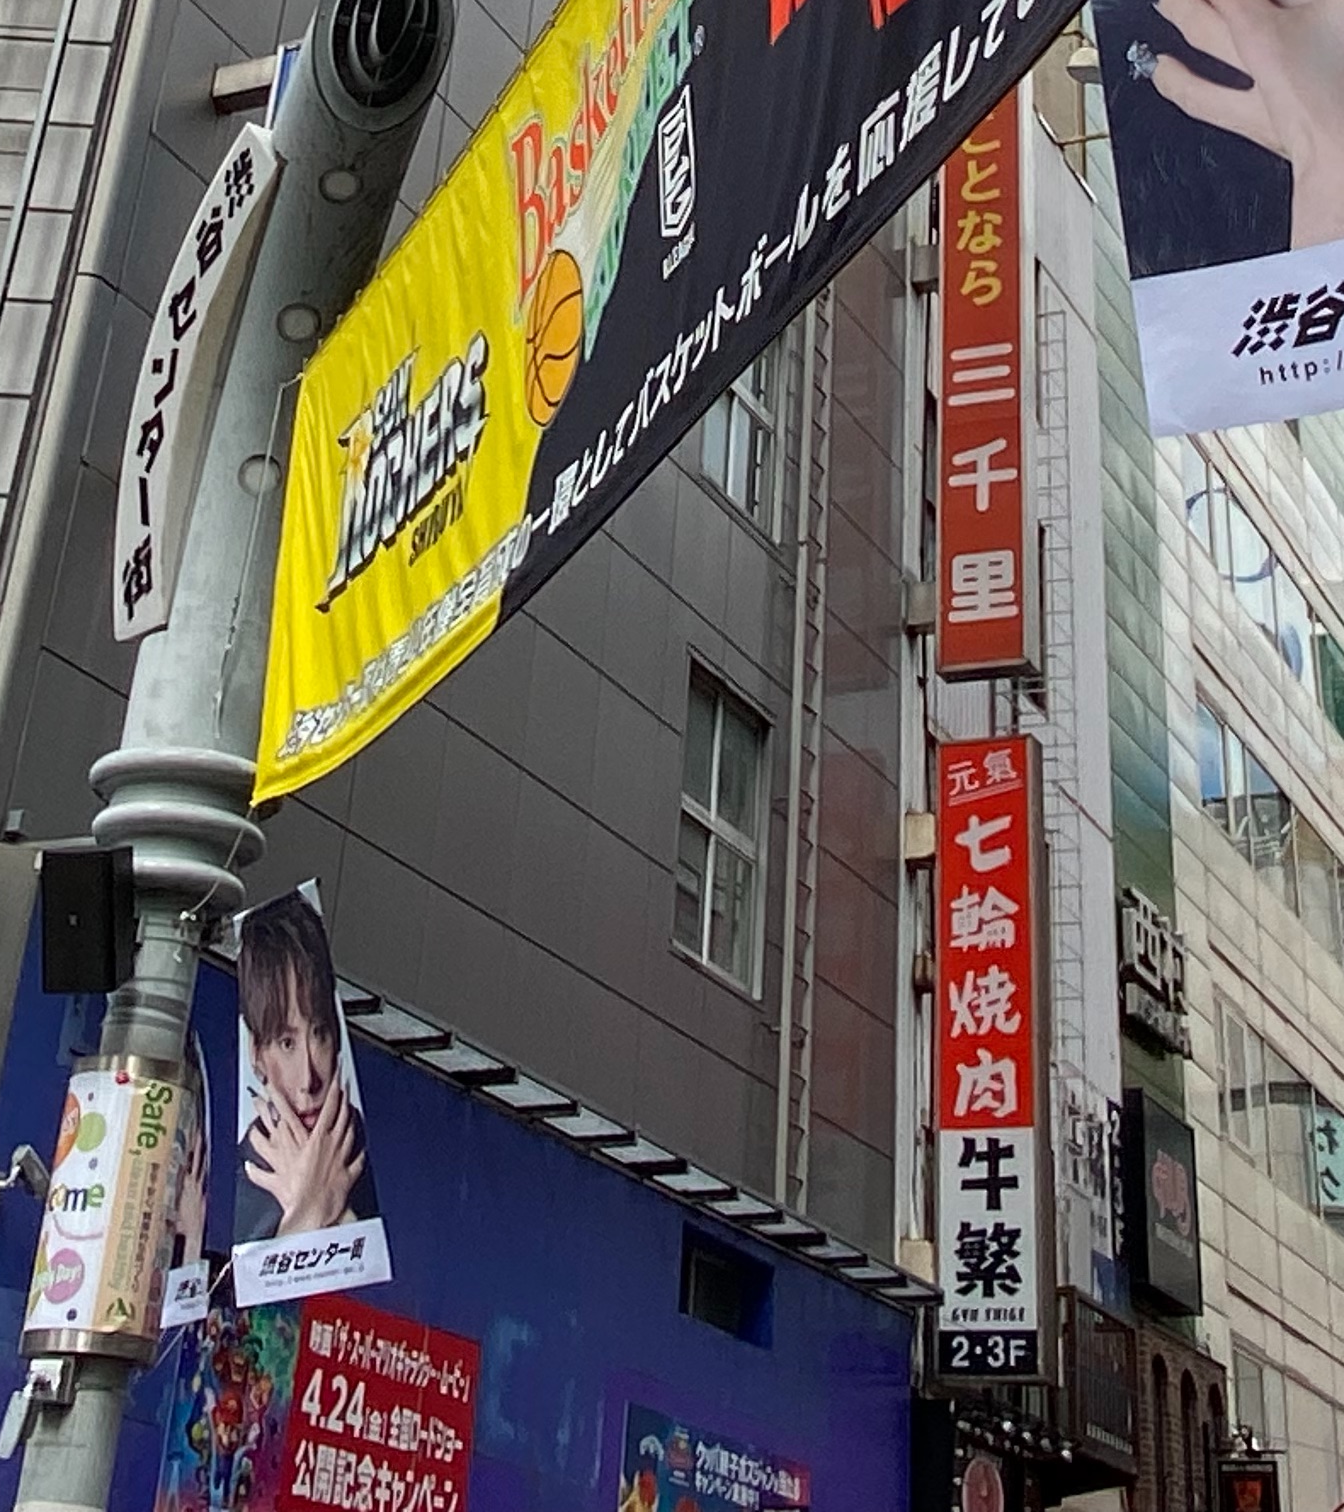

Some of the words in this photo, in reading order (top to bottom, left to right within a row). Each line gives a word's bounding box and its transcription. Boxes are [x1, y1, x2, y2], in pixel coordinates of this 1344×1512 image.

[120, 145, 257, 623] 渋谷センター街
[947, 341, 1019, 624] 三千里
[947, 812, 1022, 1120] 七輪焼肉
[130, 1082, 174, 1156] Safe,
[954, 1136, 1023, 1299] 牛繁
